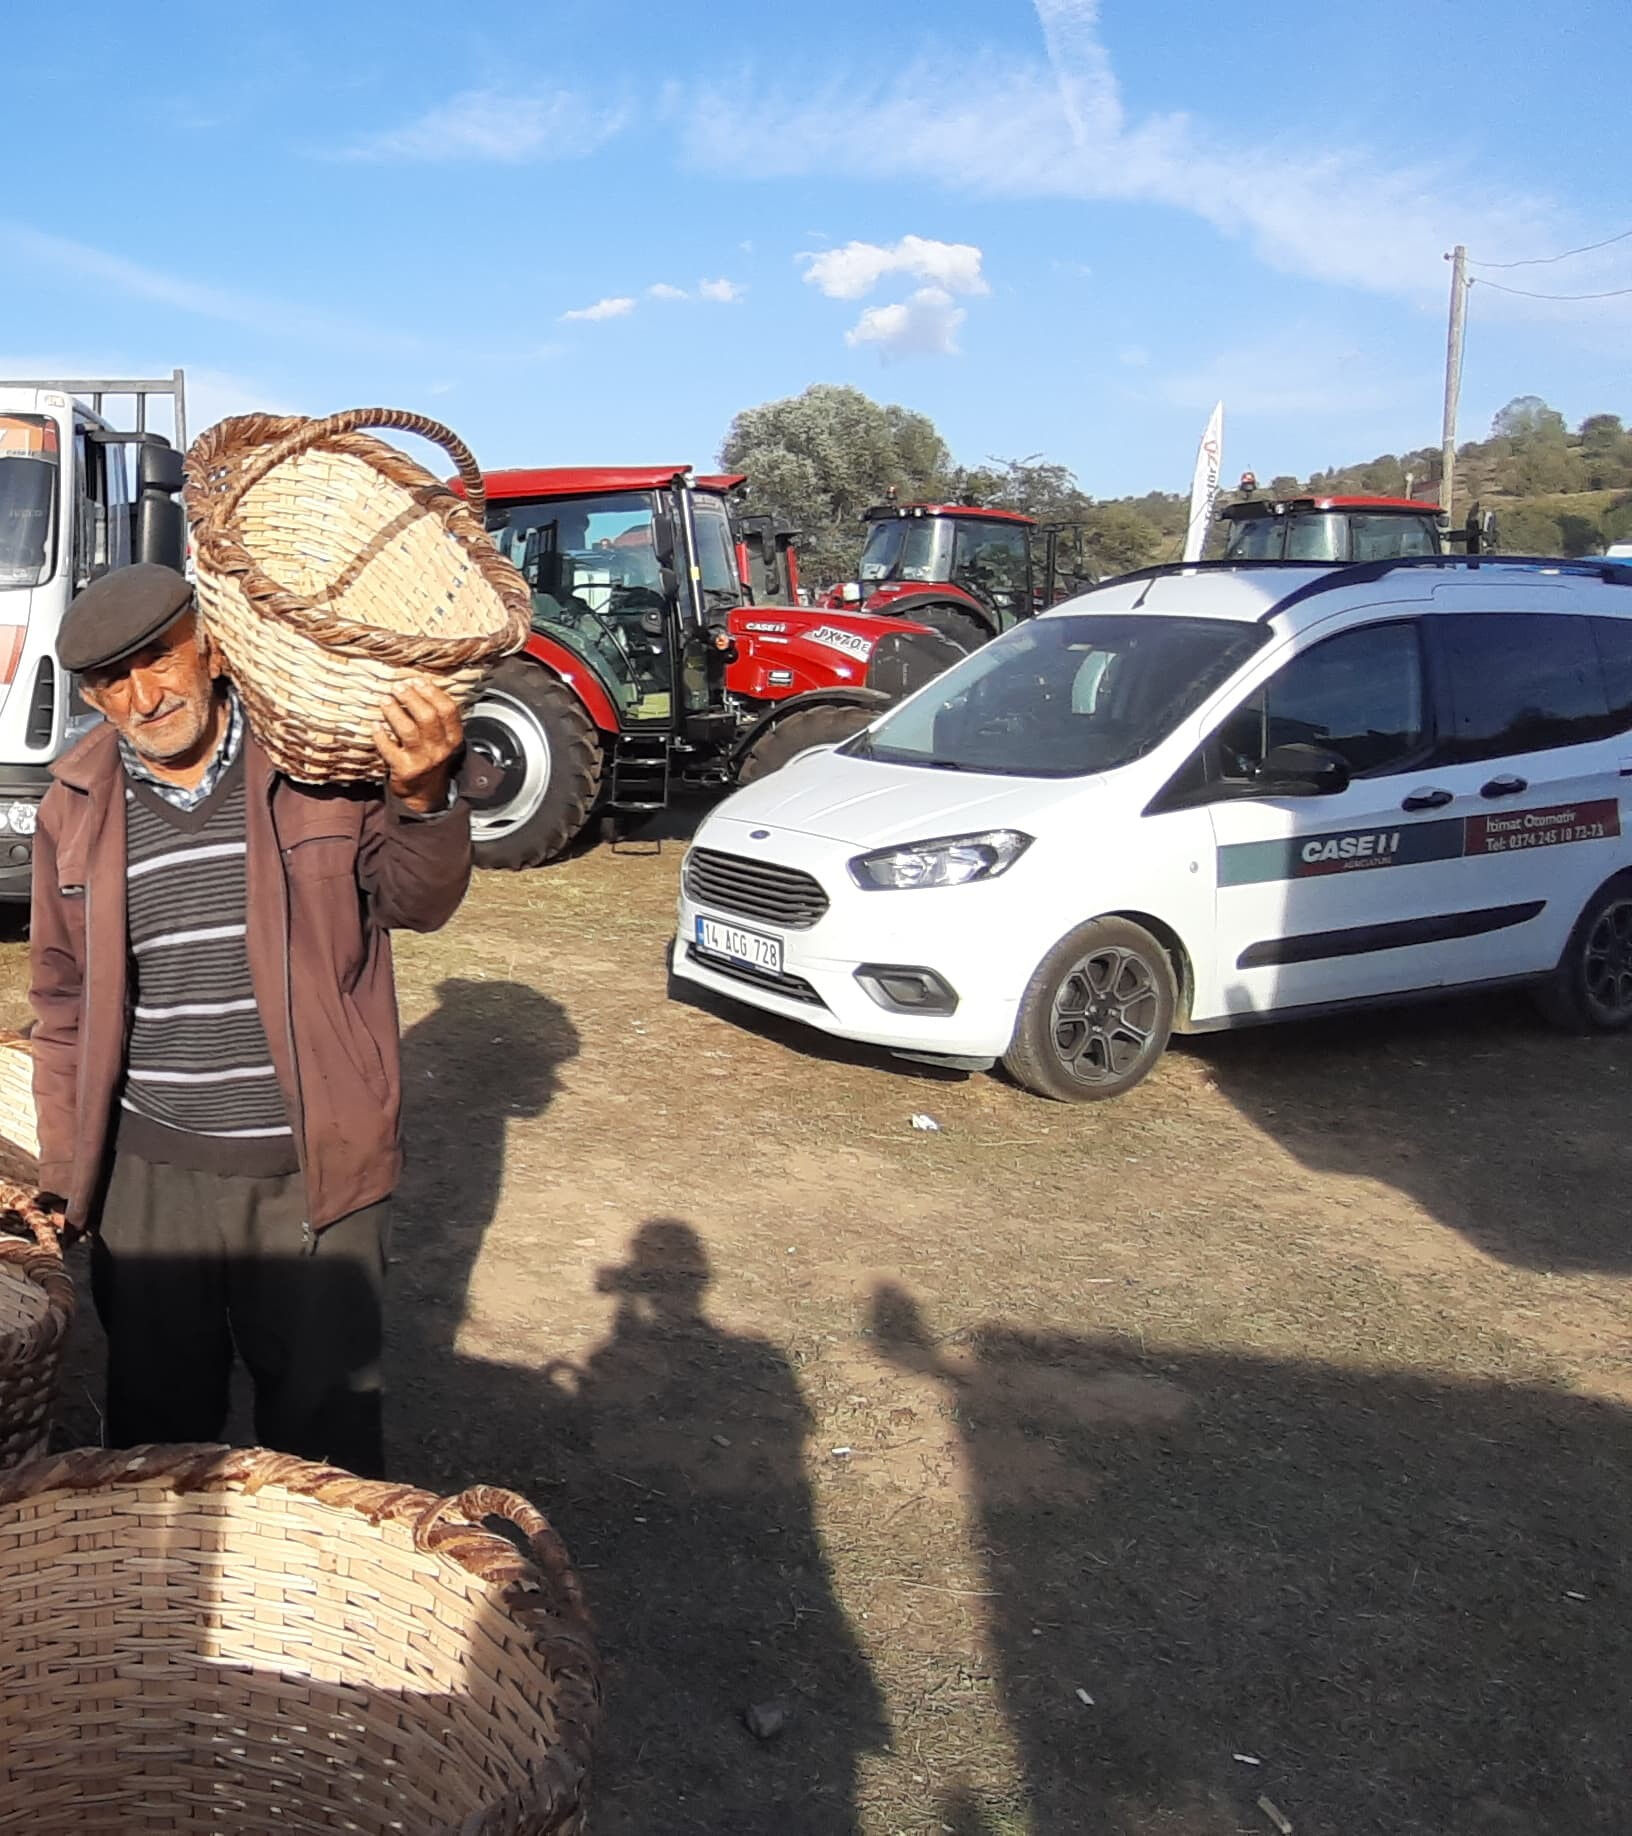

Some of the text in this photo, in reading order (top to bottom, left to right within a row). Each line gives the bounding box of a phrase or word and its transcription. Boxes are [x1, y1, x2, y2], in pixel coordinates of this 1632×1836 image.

[1524, 810, 1576, 828] Otomotiv
[1302, 835, 1376, 863] CASE
[1485, 837, 1506, 851] Tel:
[1509, 833, 1536, 849] 0374
[1538, 829, 1558, 845] 245
[705, 923, 777, 967] 14 ACG 728
